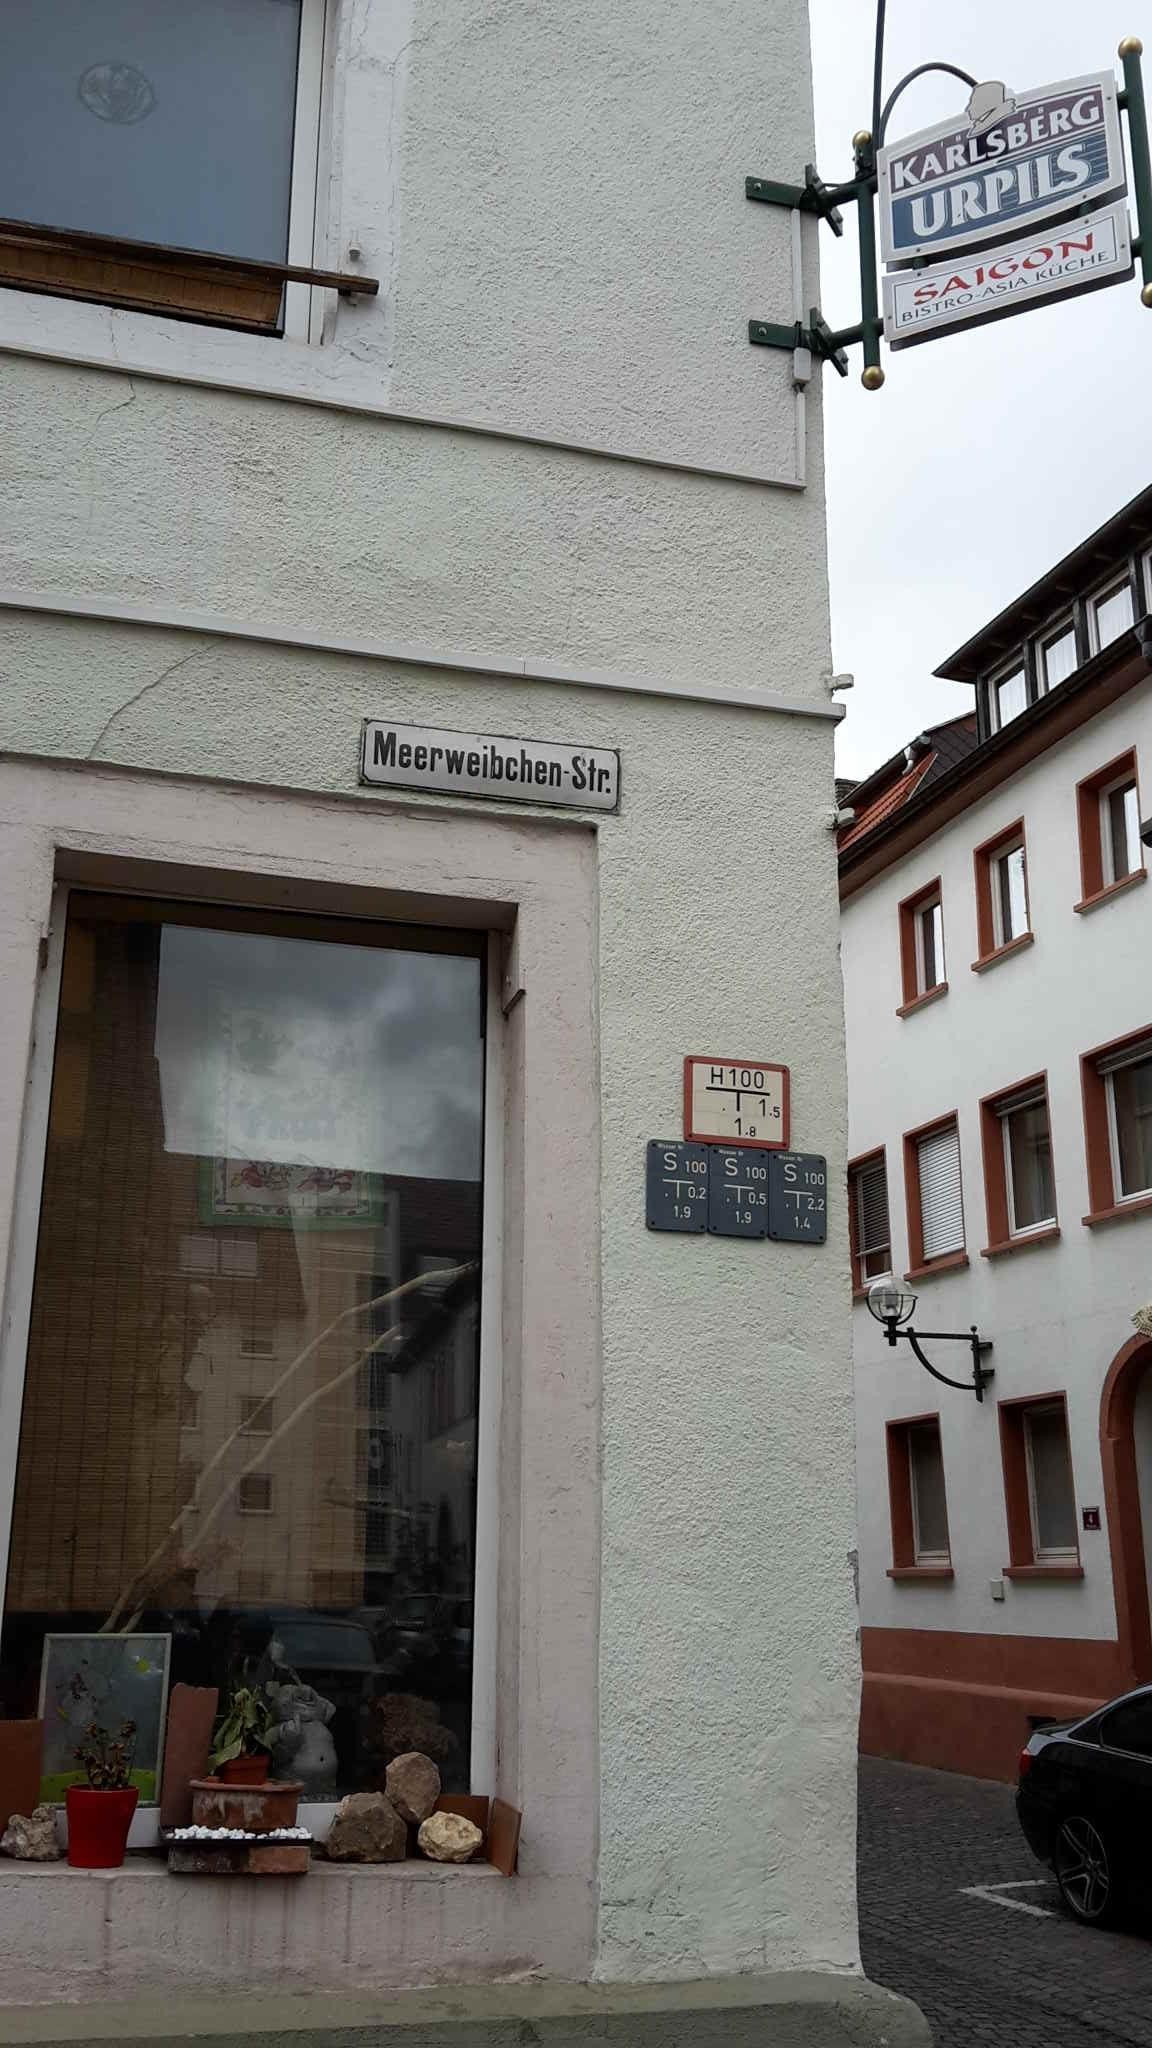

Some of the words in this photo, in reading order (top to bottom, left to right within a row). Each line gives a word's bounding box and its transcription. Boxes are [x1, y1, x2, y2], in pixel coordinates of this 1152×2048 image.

[892, 94, 1100, 190] KARLSBERG
[910, 143, 1091, 237] URPILS
[901, 277, 1029, 322] BISTRO-ASIA
[1034, 251, 1110, 282] KÜCHE
[913, 232, 1094, 306] SAIGON
[373, 730, 612, 794] Meerweibchen-Str.
[734, 1117, 757, 1138] 1.8
[758, 1098, 781, 1119] 1.5
[663, 1152, 678, 1171] S
[685, 1160, 708, 1174] 100
[724, 1157, 739, 1176] S
[745, 1166, 767, 1180] 100
[783, 1163, 798, 1182] S
[804, 1171, 826, 1185] 100
